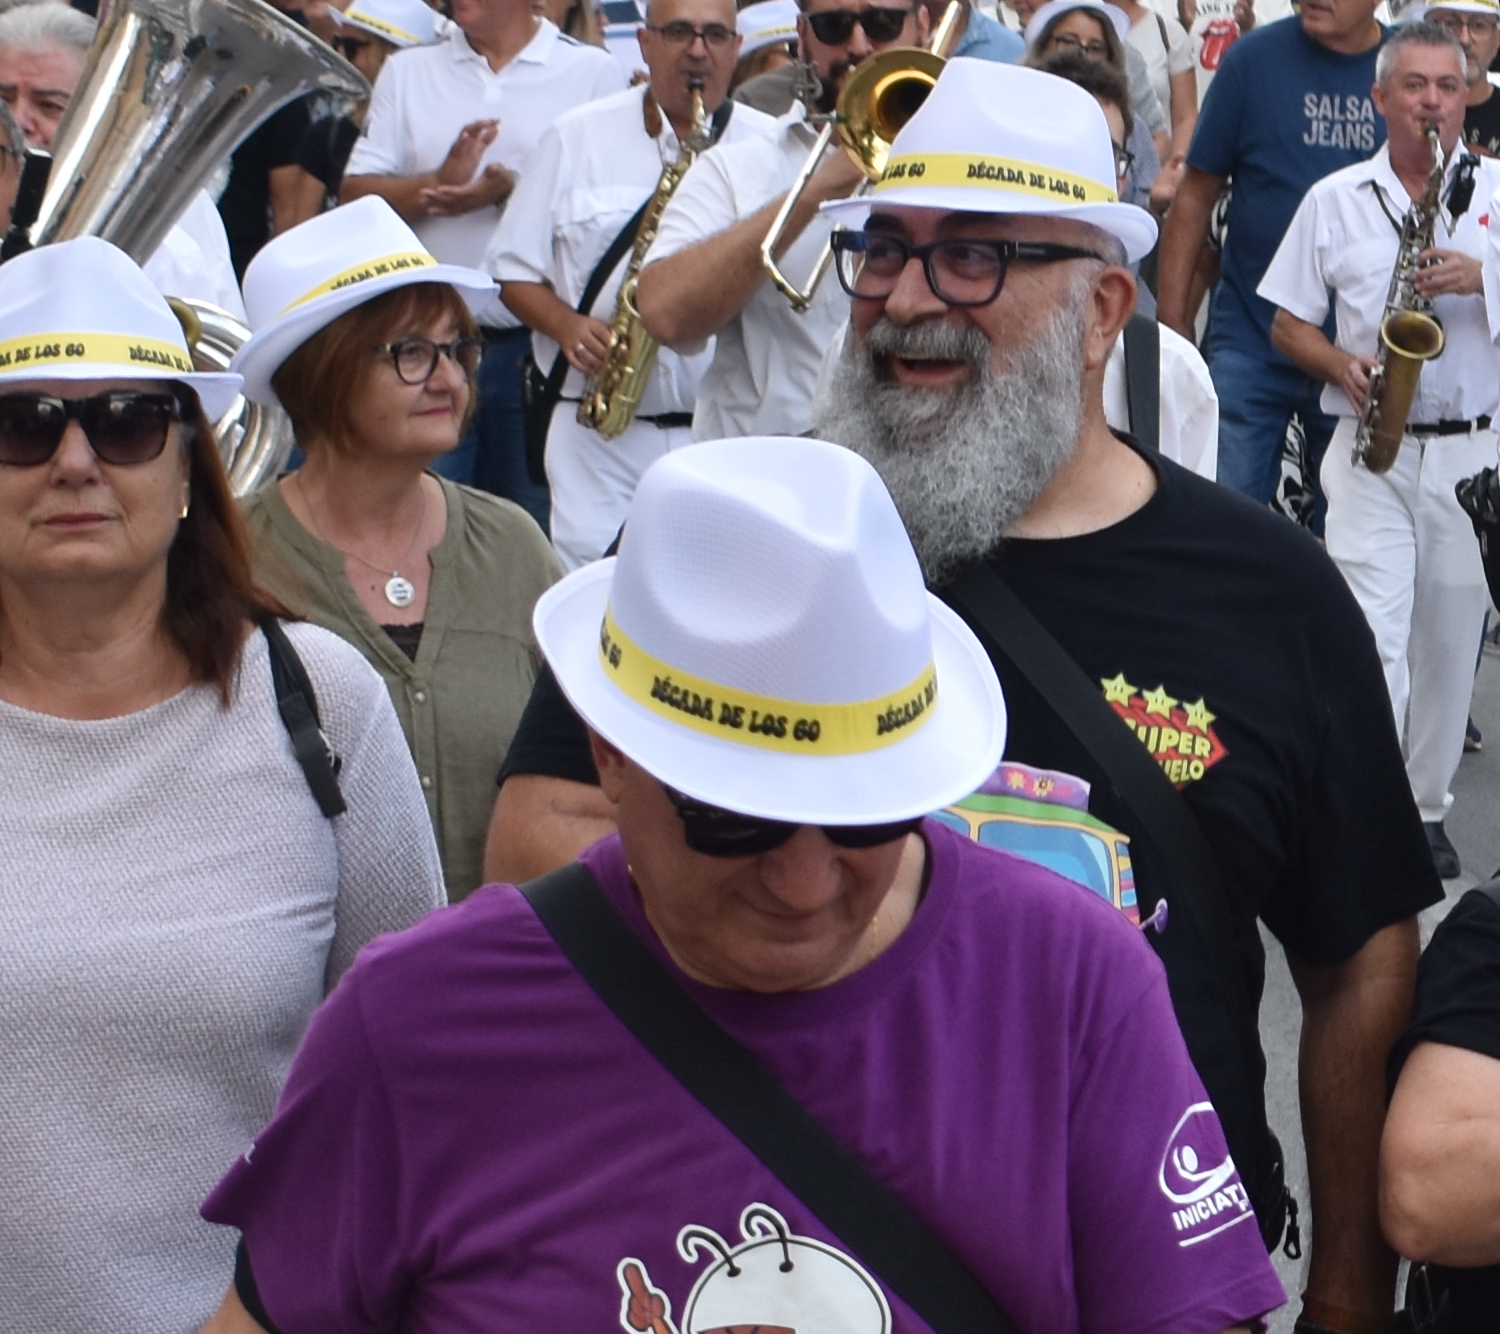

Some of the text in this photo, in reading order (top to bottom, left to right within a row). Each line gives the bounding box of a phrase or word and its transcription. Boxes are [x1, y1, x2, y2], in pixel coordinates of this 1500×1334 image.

[1303, 92, 1376, 124] SALSA
[1302, 119, 1376, 151] JEANS
[966, 161, 1026, 186] DÉCADA
[1029, 172, 1046, 190] DE
[1048, 178, 1070, 196] LOS
[14, 347, 31, 364] DE
[34, 344, 61, 360] LOS
[649, 674, 715, 724] DÉCADA
[717, 703, 746, 730] DE
[748, 710, 788, 740] LOS
[1124, 717, 1212, 759] UPER
